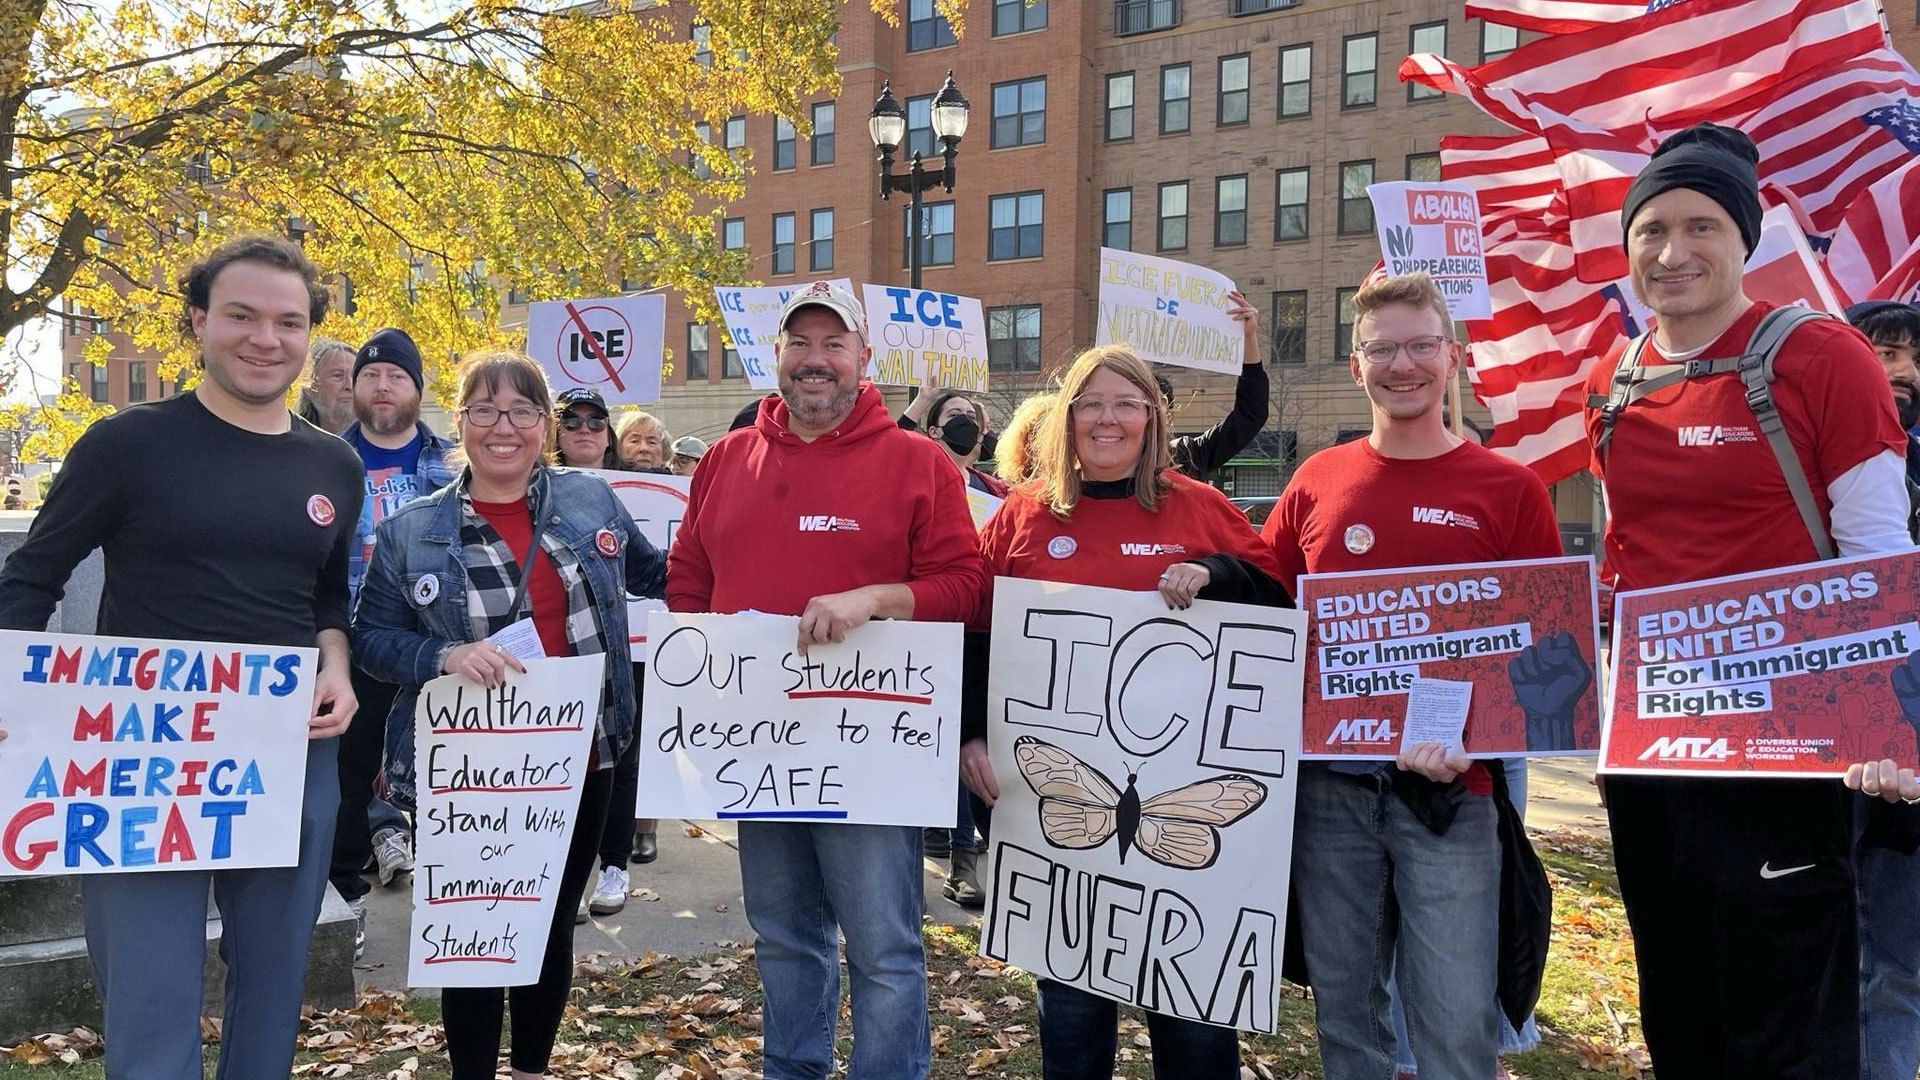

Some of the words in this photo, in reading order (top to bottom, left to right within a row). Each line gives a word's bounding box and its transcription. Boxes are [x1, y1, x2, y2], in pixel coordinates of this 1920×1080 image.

[1386, 225, 1413, 257] NO
[719, 291, 745, 313] ICE
[1103, 259, 1158, 292] ICE
[1163, 271, 1230, 313] FUERA
[886, 288, 962, 329] ICE
[1156, 297, 1179, 316] DE
[570, 329, 625, 362] ICE
[731, 327, 755, 346] ICE
[883, 322, 940, 349] OUT
[947, 329, 975, 352] OF
[744, 357, 766, 377] ICE
[871, 346, 989, 392] WALTHAM
[1678, 426, 1724, 446] WEA
[366, 477, 418, 495] bolish
[799, 516, 837, 531] WEA
[1412, 506, 1455, 526] WEA
[1120, 543, 1163, 555] WEA
[1316, 576, 1502, 620] EDUCATORS
[1638, 571, 1878, 638] EDUCATORS
[1318, 612, 1430, 643] UNITED
[1639, 621, 1785, 663] UNITED
[653, 626, 757, 695] Our
[1325, 643, 1369, 668] For
[1375, 628, 1522, 660] Immigrant
[1645, 664, 1704, 687] For
[1712, 629, 1909, 682] Immigrant
[22, 644, 301, 697] IMMIGRANTS
[1327, 670, 1415, 697] Rights
[426, 685, 584, 731] Waltham
[1004, 608, 1296, 778] ICE
[1646, 688, 1766, 717] Rights
[73, 702, 220, 743] MAKE
[658, 706, 807, 753] deserve
[837, 708, 870, 744] to
[891, 710, 942, 758] feel
[1326, 719, 1399, 744] MTA
[1637, 737, 1739, 760] MTA
[1745, 746, 1756, 754] of
[1758, 746, 1818, 754] EDUCATION
[1755, 738, 1798, 746] DIVERSE
[1800, 738, 1834, 746] UNION
[24, 756, 266, 798] AMERICA
[428, 743, 572, 791] Educators
[715, 758, 844, 810] SAFE
[2, 800, 248, 871] GREAT
[480, 843, 514, 861] our
[423, 863, 550, 911] Immigrant
[422, 922, 519, 960] Students
[986, 842, 1276, 1033] FUERA
